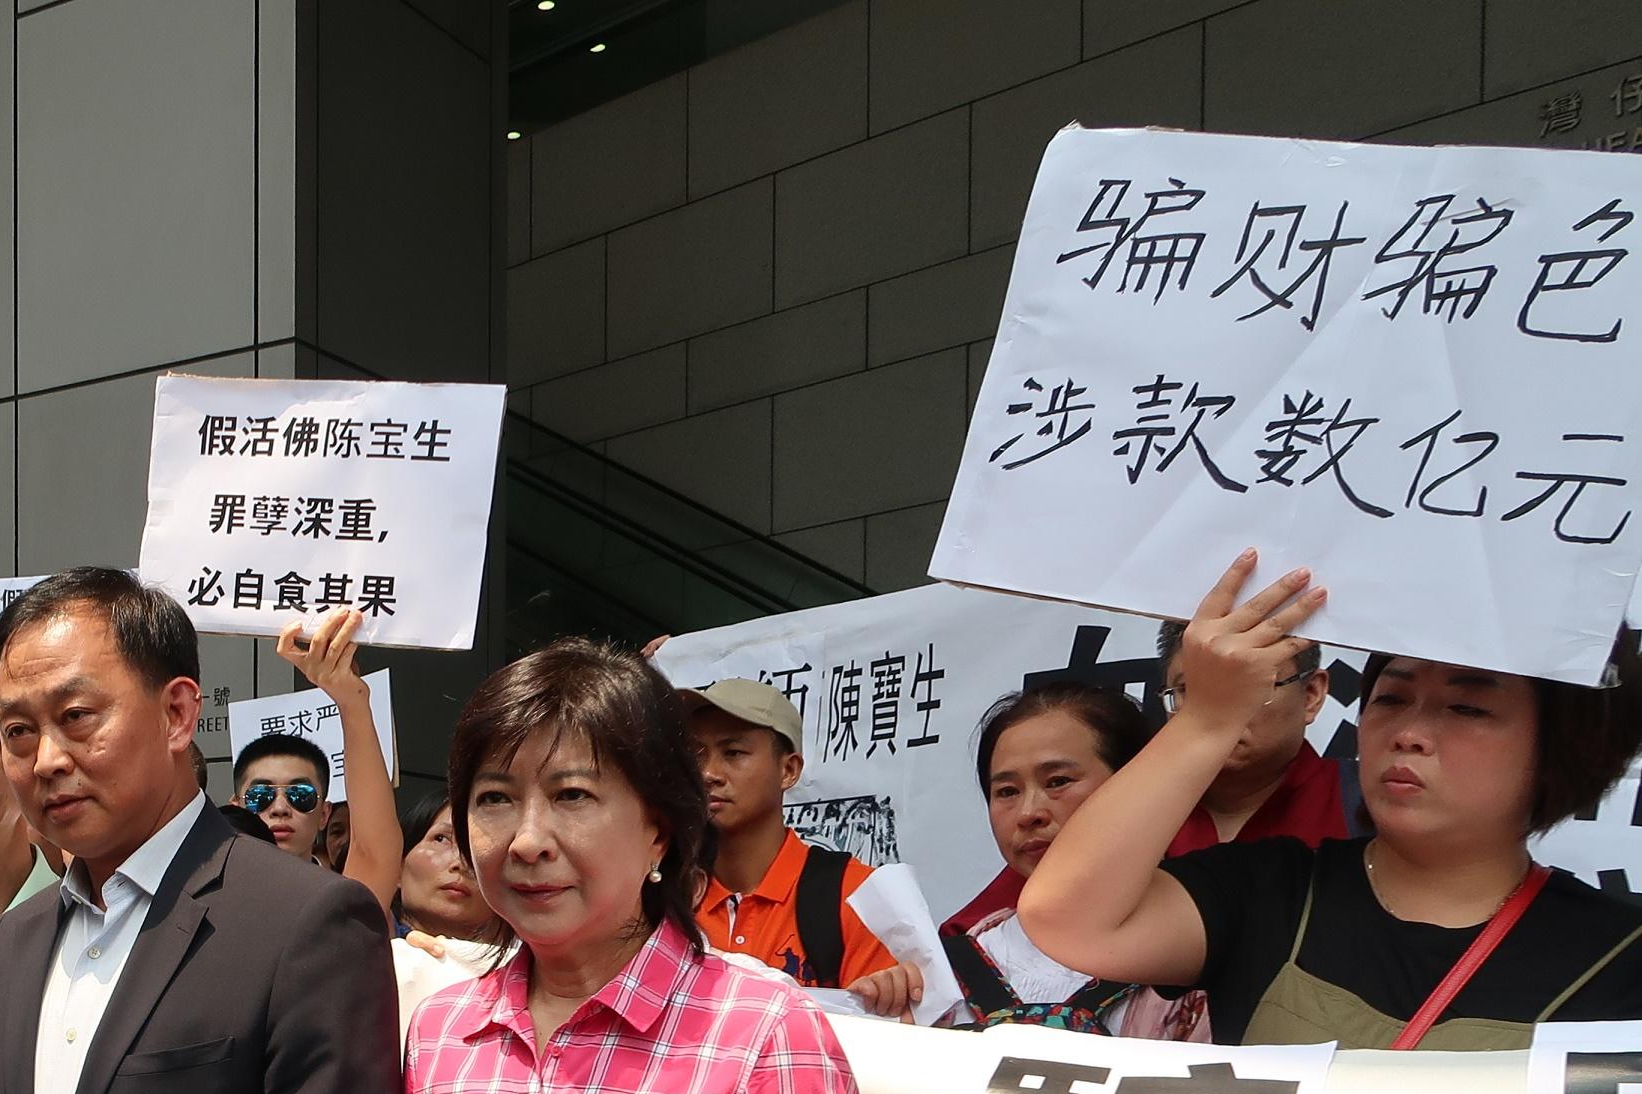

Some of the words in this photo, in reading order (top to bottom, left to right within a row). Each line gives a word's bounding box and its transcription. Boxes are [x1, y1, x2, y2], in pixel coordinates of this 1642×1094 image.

[1056, 178, 1634, 342] 骗财骗色
[198, 414, 452, 462] 假活佛陈宝生
[989, 374, 1633, 545] 涉款数亿元
[188, 567, 397, 617] 必自食其果
